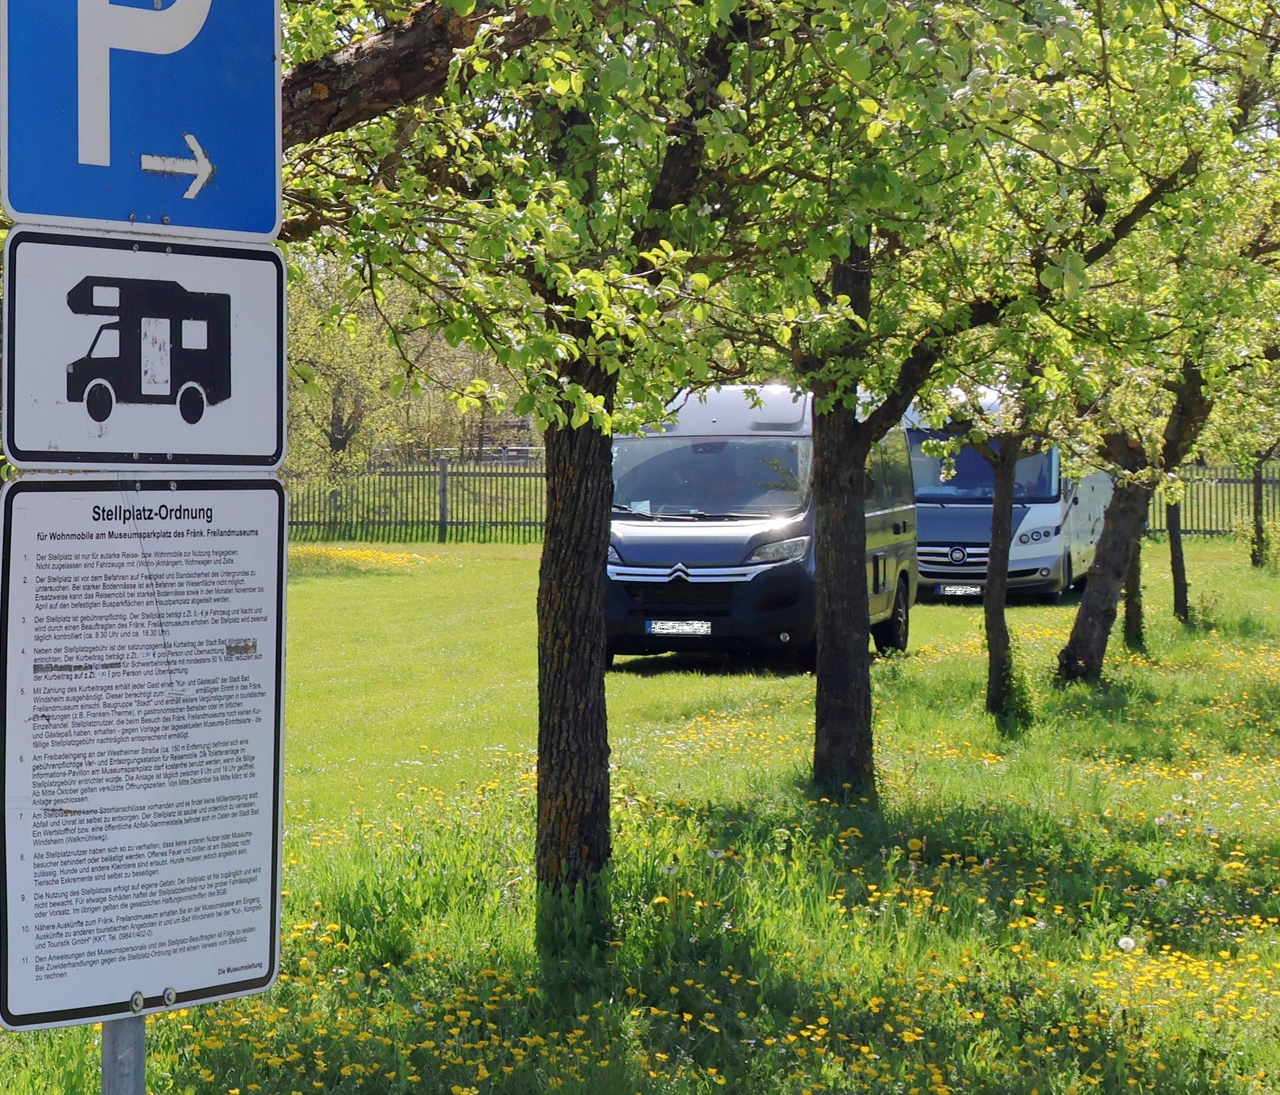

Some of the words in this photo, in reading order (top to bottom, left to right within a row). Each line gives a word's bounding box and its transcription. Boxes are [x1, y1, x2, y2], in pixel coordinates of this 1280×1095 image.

[92, 505, 212, 524] Stellplatz-Ordnung
[37, 532, 47, 540] für
[49, 532, 93, 540] Wohnmobile
[108, 530, 172, 540] Museumsparkplatz
[173, 530, 184, 538] des
[48, 553, 72, 562] Stellplatz
[52, 562, 82, 570] zugelassen
[47, 575, 72, 584] Stellplatz
[35, 603, 48, 611] April
[46, 615, 71, 624] Stellplatz
[34, 633, 52, 642] täglich
[33, 695, 64, 703] Windsheim
[45, 731, 72, 739] Gästepaß
[33, 741, 49, 749] fällige
[80, 787, 97, 795] gelten
[43, 827, 76, 836] Wertstoffhof
[33, 837, 64, 846] Windsheim
[33, 861, 59, 869] besucher
[60, 858, 86, 866] behindert
[34, 878, 59, 887] Tierische
[61, 876, 93, 884] Exkremente
[57, 920, 84, 929] Auskünfte
[36, 931, 63, 940] Auskünfte
[48, 938, 70, 947] Touristik
[48, 952, 85, 961] Anweisungen
